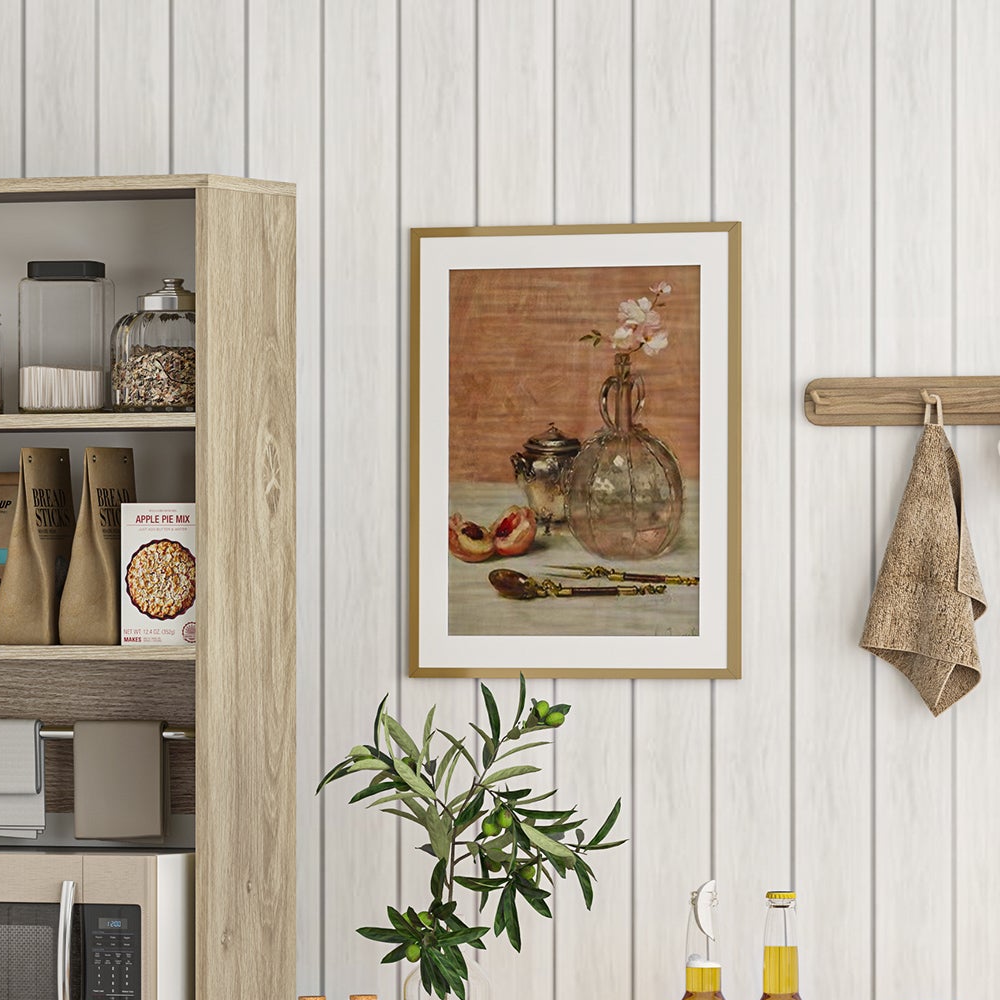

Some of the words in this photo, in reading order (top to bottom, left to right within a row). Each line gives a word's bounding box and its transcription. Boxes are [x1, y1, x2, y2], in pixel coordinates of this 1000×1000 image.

[32, 488, 66, 507] BREAD
[96, 488, 130, 507] BREAD
[34, 508, 71, 527] STICKS
[135, 515, 160, 524] APPLE
[161, 515, 174, 524] PIE
[175, 515, 190, 524] MIX
